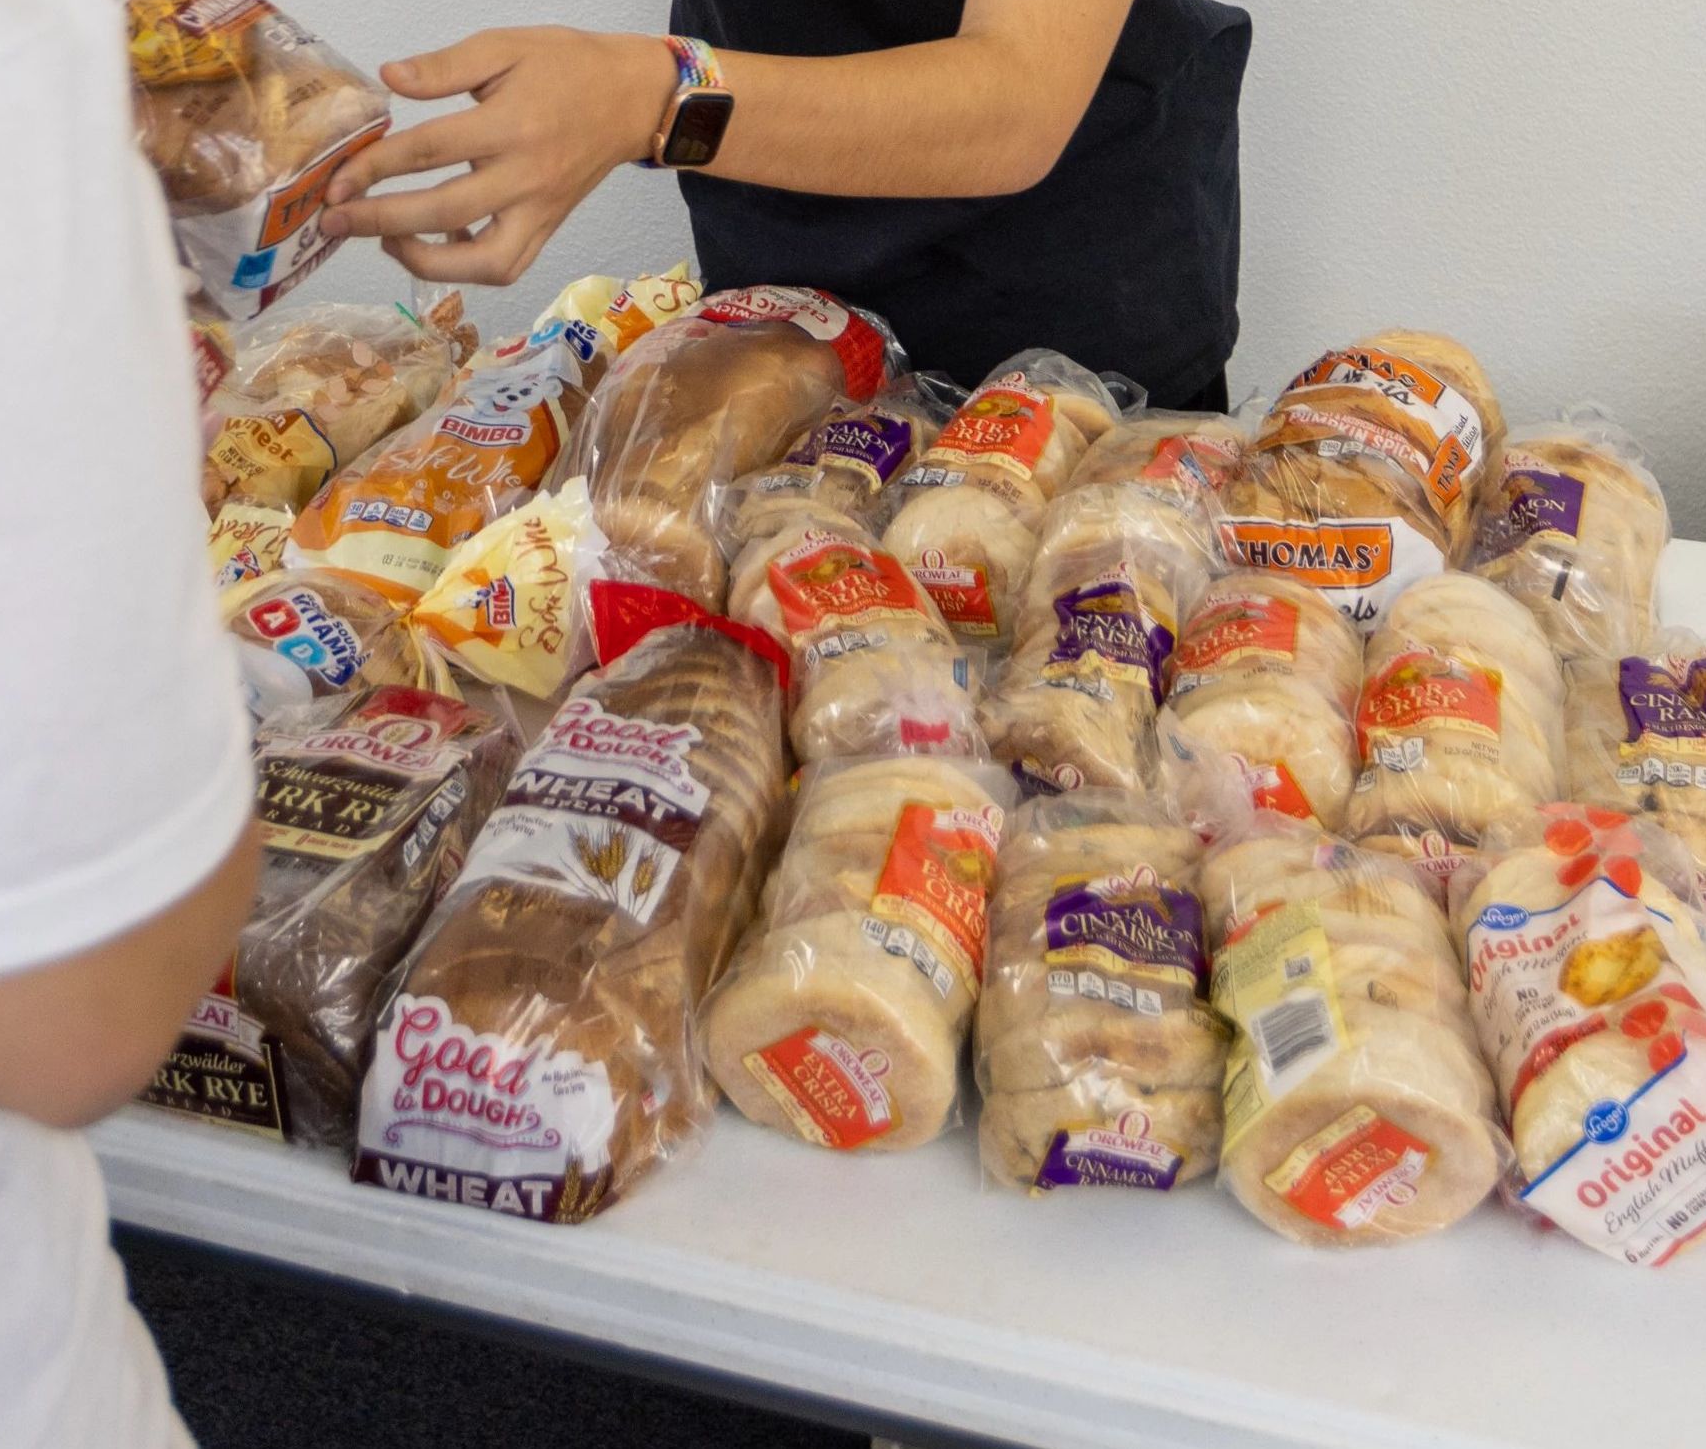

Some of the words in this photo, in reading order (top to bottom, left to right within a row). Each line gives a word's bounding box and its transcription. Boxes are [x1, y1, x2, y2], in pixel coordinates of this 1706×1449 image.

[440, 416, 525, 444] BIMBO
[1288, 409, 1368, 443] PUMPKIN
[550, 701, 691, 747] Good
[506, 770, 678, 824] WHEAT
[542, 796, 621, 817] BREAD
[925, 877, 986, 940] CRIS
[1480, 906, 1528, 926] Kroger
[1470, 912, 1581, 994] Original
[1516, 987, 1539, 1002] NO
[168, 1051, 246, 1074] rzwälder
[395, 1004, 539, 1097] Good
[793, 1064, 844, 1118] CRISP
[802, 1052, 858, 1120] EXTRA
[830, 1040, 884, 1103] OROWEAT
[204, 1075, 269, 1108] RYE
[393, 1087, 414, 1112] to
[1586, 1106, 1624, 1139] Kroger
[1088, 1130, 1163, 1157] OROWEAT
[1065, 1154, 1159, 1186] CINNAMON
[1324, 1141, 1377, 1186] CRISP
[1329, 1147, 1398, 1195] EXTRA
[378, 1158, 553, 1217] WHEAT
[1357, 1163, 1417, 1214] OROWEAT
[1604, 1179, 1663, 1235] English
[1666, 1209, 1690, 1231] NO
[1624, 1248, 1638, 1264] 6
